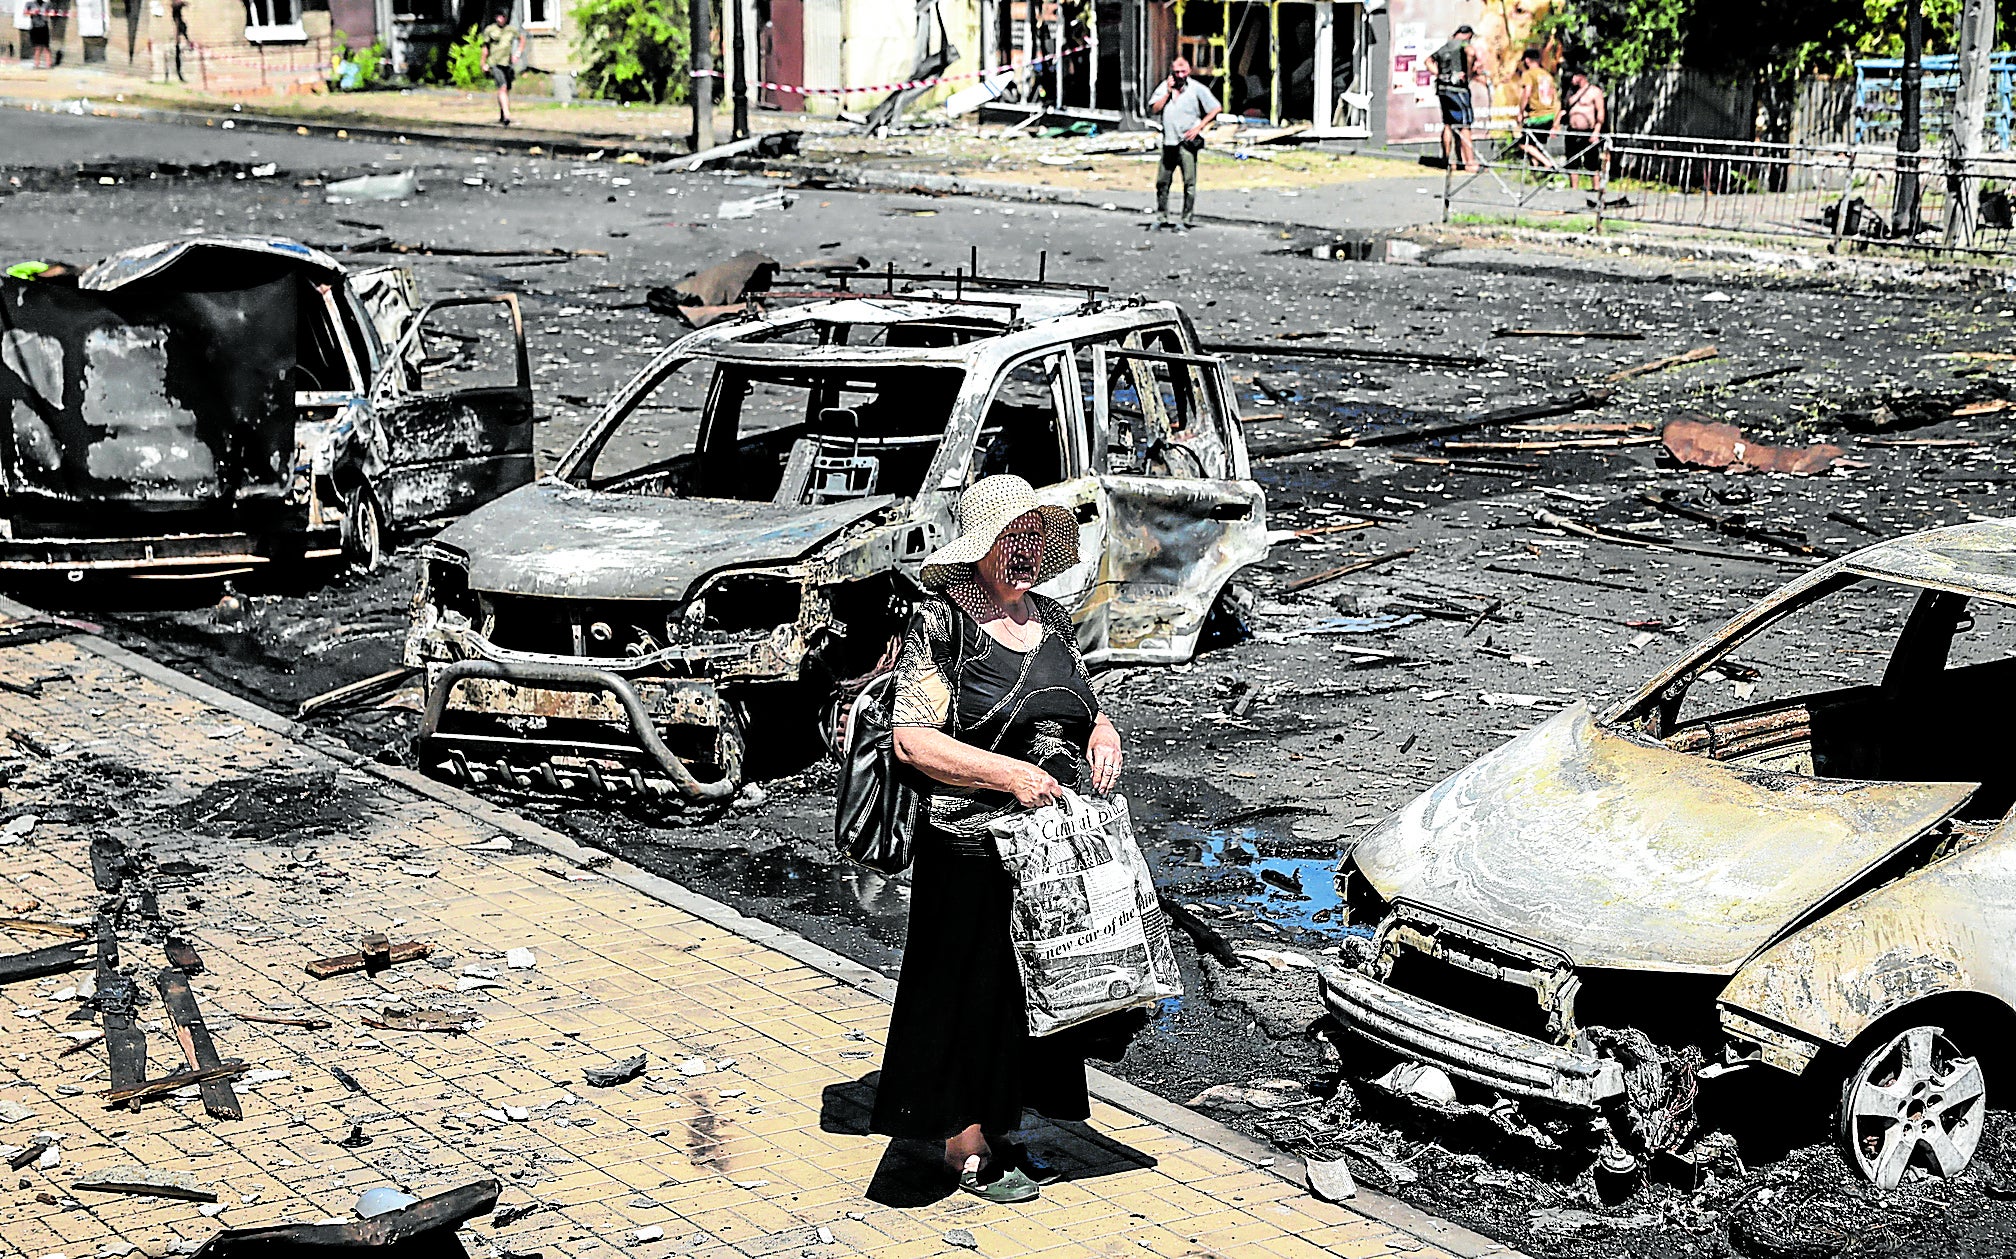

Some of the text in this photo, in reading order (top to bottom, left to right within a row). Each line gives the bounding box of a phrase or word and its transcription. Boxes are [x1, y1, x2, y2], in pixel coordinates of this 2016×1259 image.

[1046, 940, 1073, 960] new
[1077, 929, 1100, 946] car
[1103, 916, 1117, 937] of
[1118, 908, 1135, 927] the
